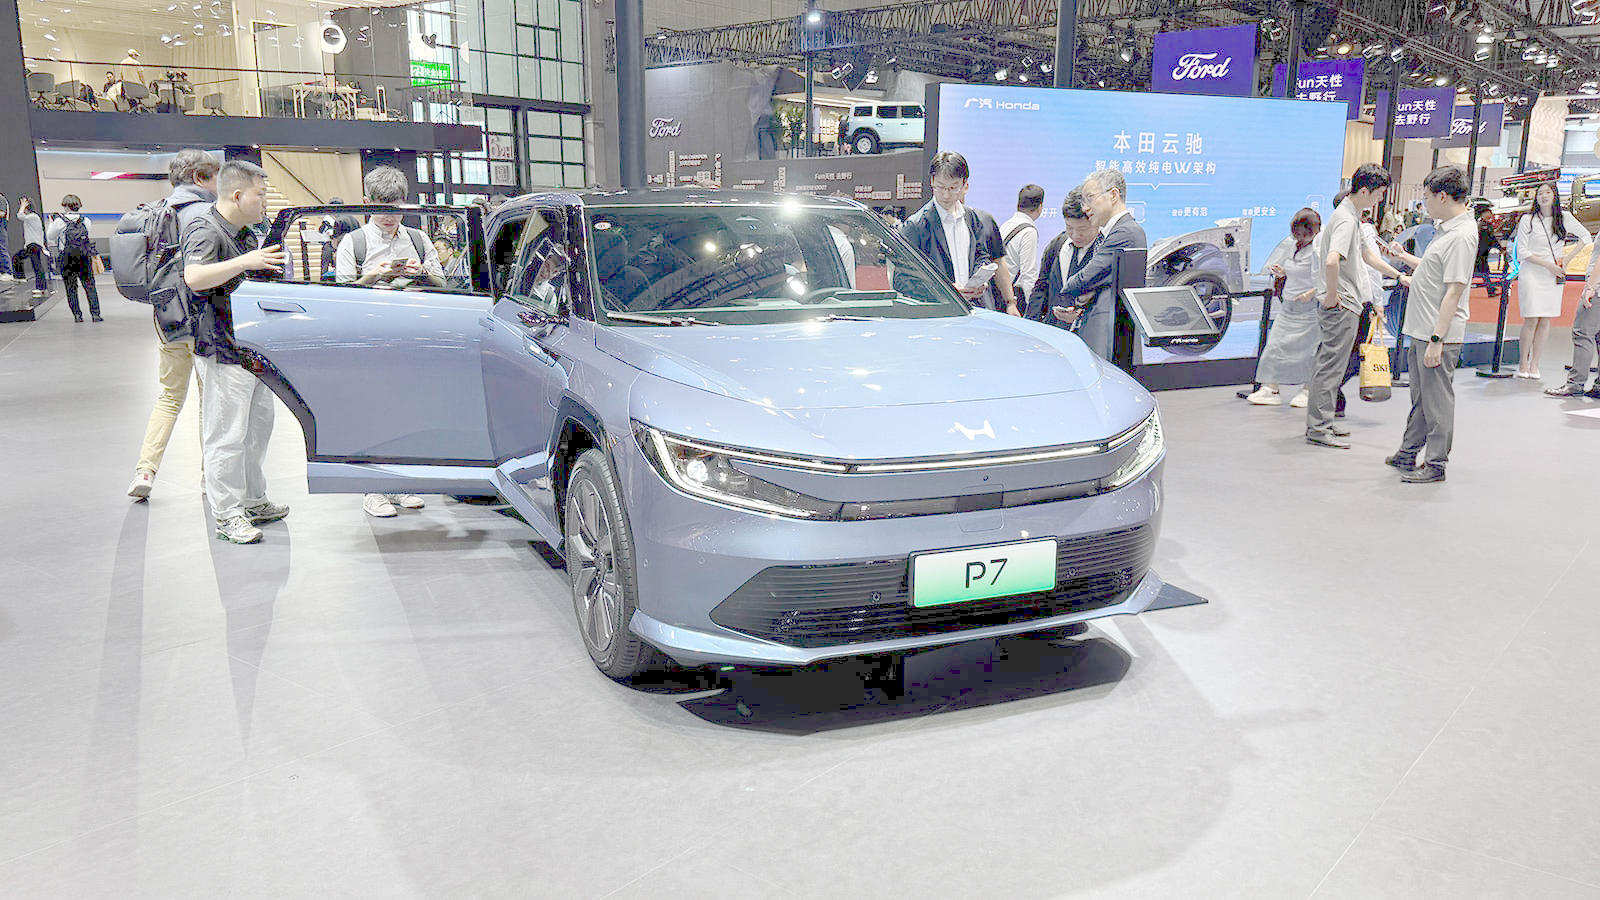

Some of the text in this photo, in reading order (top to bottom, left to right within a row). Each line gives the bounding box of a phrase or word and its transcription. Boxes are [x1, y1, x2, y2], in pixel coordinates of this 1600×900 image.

[1172, 53, 1231, 80] Ford
[1296, 74, 1343, 89] un天性
[996, 101, 1040, 111] Honda
[1397, 100, 1436, 112] un天性
[1394, 113, 1431, 125] 去野行
[649, 118, 681, 138] Ford
[1113, 130, 1202, 155] 本田云驰
[1095, 160, 1217, 175] 智能高效纯电W架构
[965, 558, 1008, 589] P7
